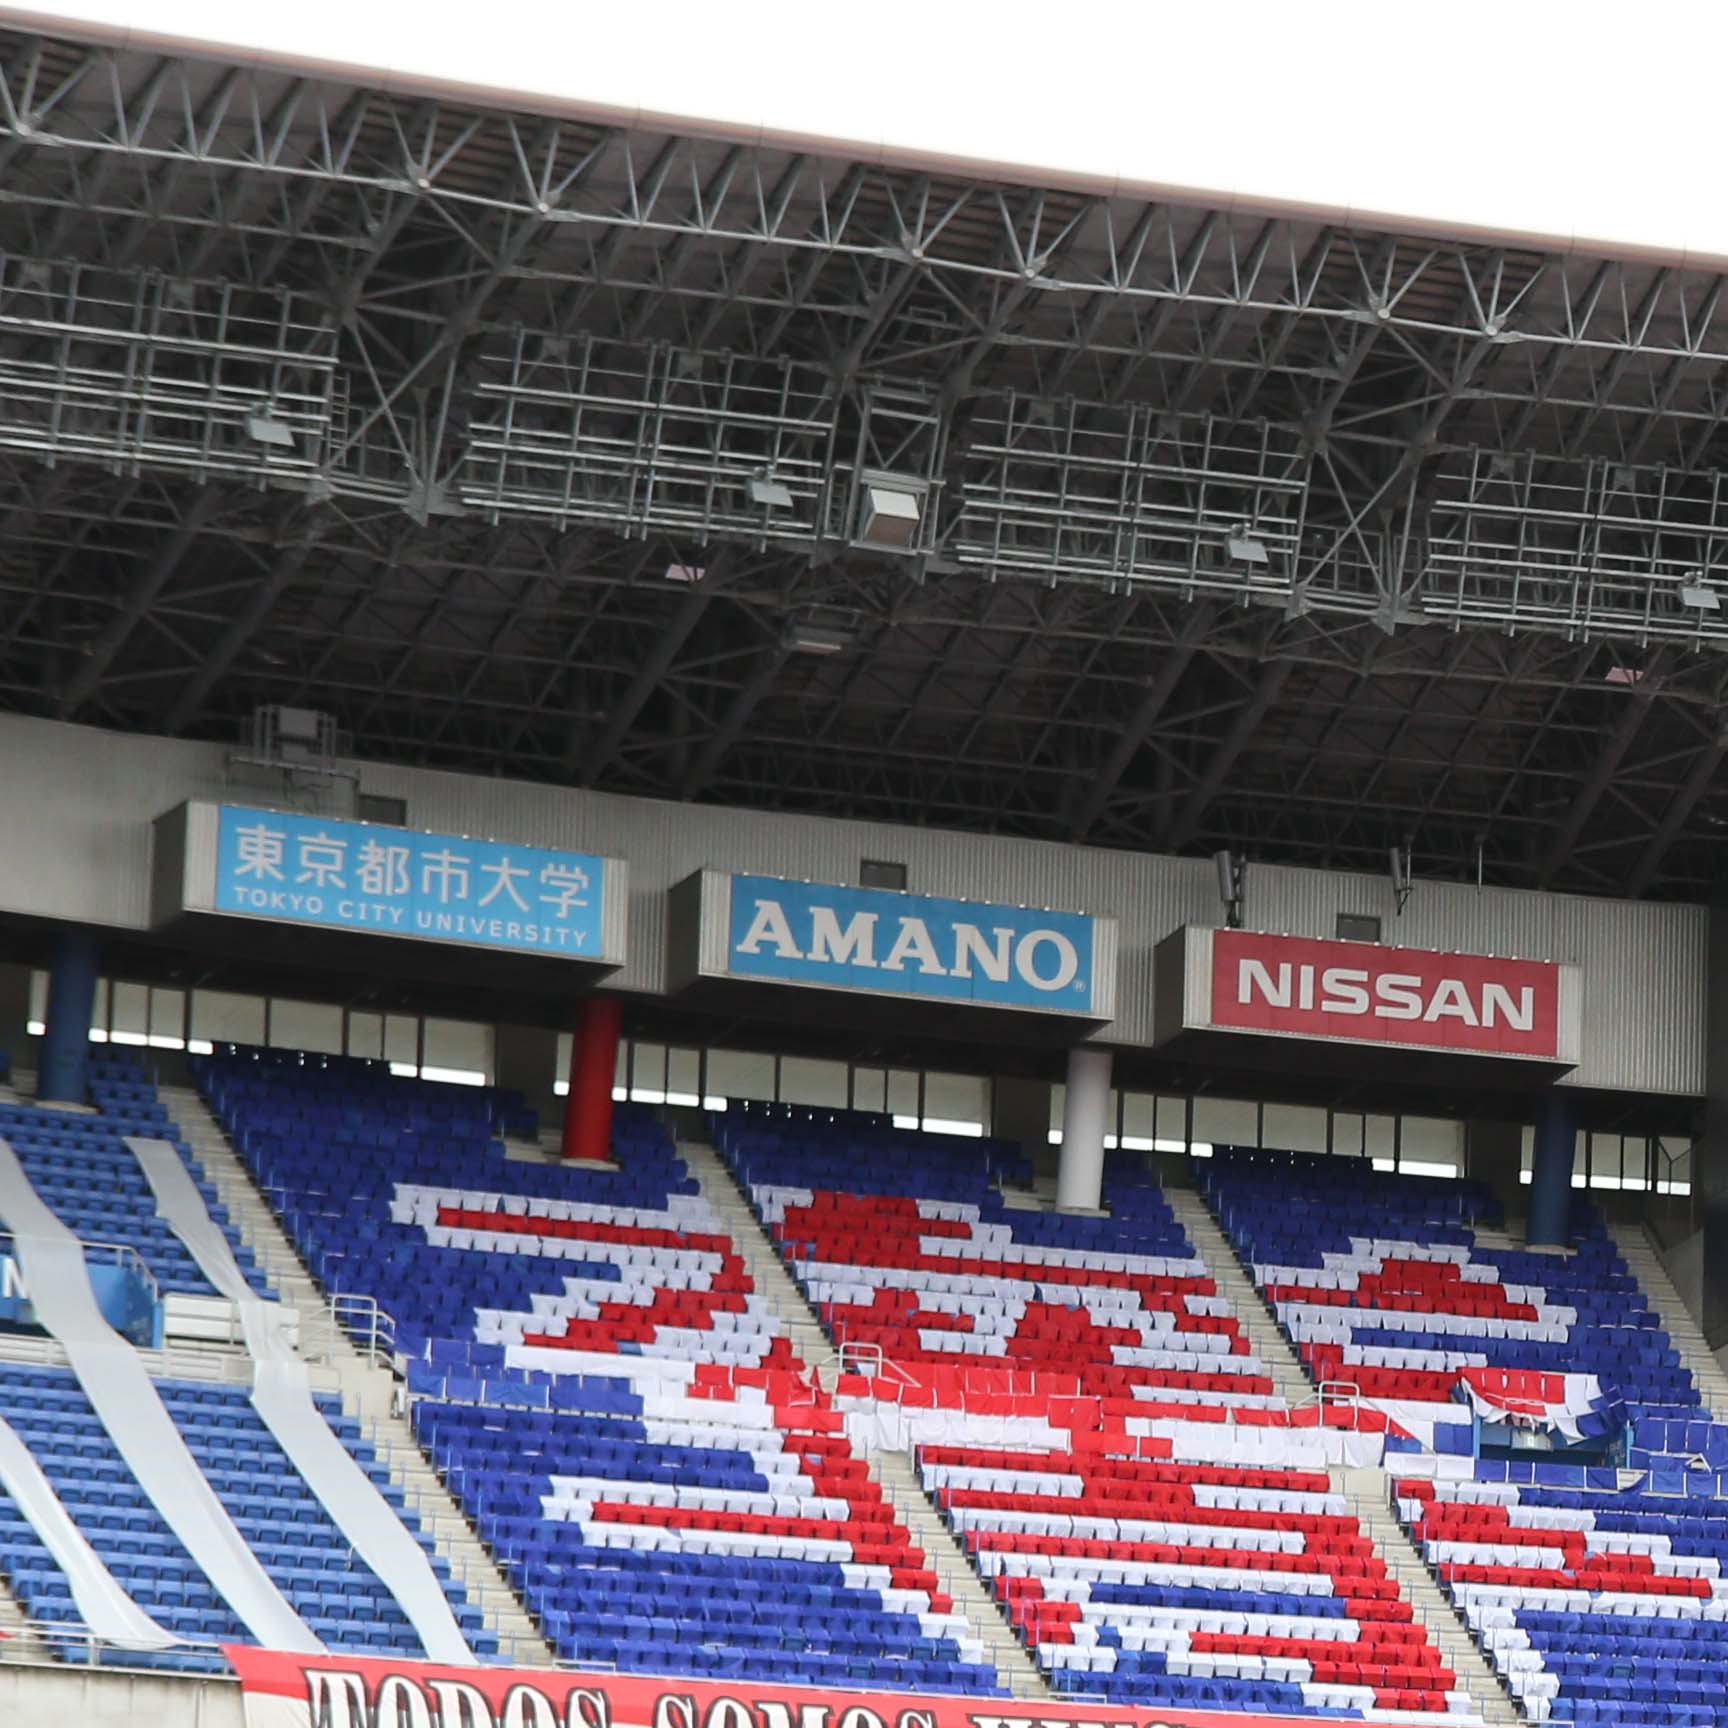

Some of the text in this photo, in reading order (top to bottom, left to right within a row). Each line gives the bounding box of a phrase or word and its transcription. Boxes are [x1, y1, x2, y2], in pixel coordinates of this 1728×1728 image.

[234, 823, 590, 922] 東京都市大学
[232, 885, 589, 948] TOKYO CITY UNIVERSITY
[736, 898, 1080, 992] AMANO
[1238, 958, 1534, 1032] NISSAN
